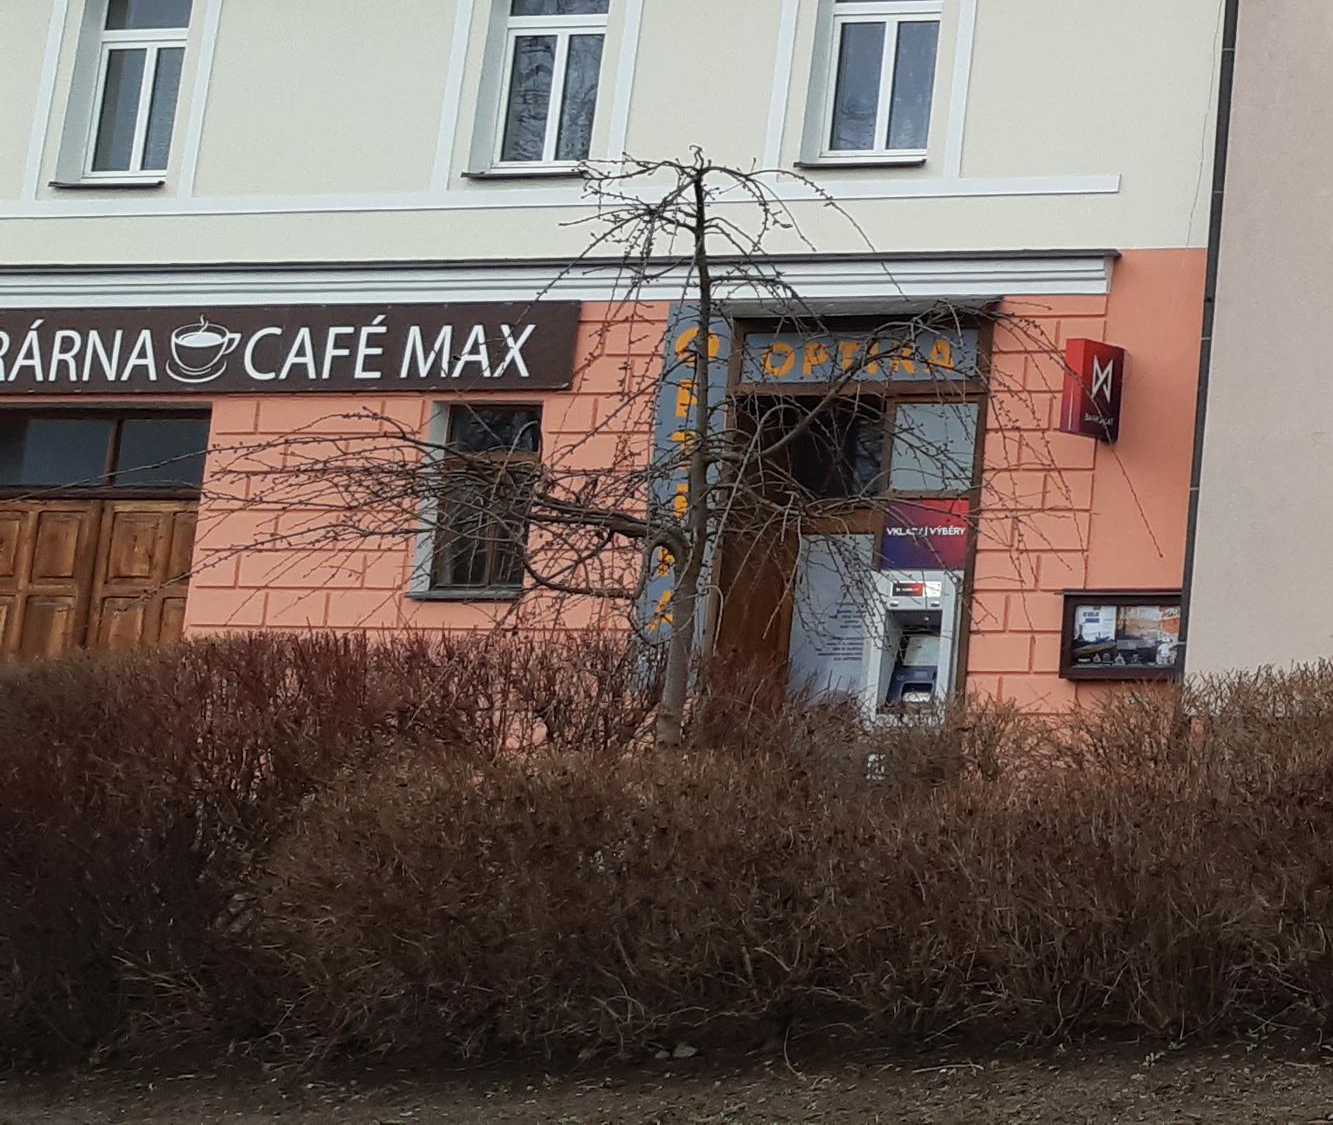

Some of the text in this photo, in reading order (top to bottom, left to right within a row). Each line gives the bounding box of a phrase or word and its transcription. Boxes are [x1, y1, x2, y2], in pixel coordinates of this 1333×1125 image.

[243, 314, 388, 381] CAFÉ
[399, 324, 537, 379] MAX
[762, 339, 956, 376] OPTIKA
